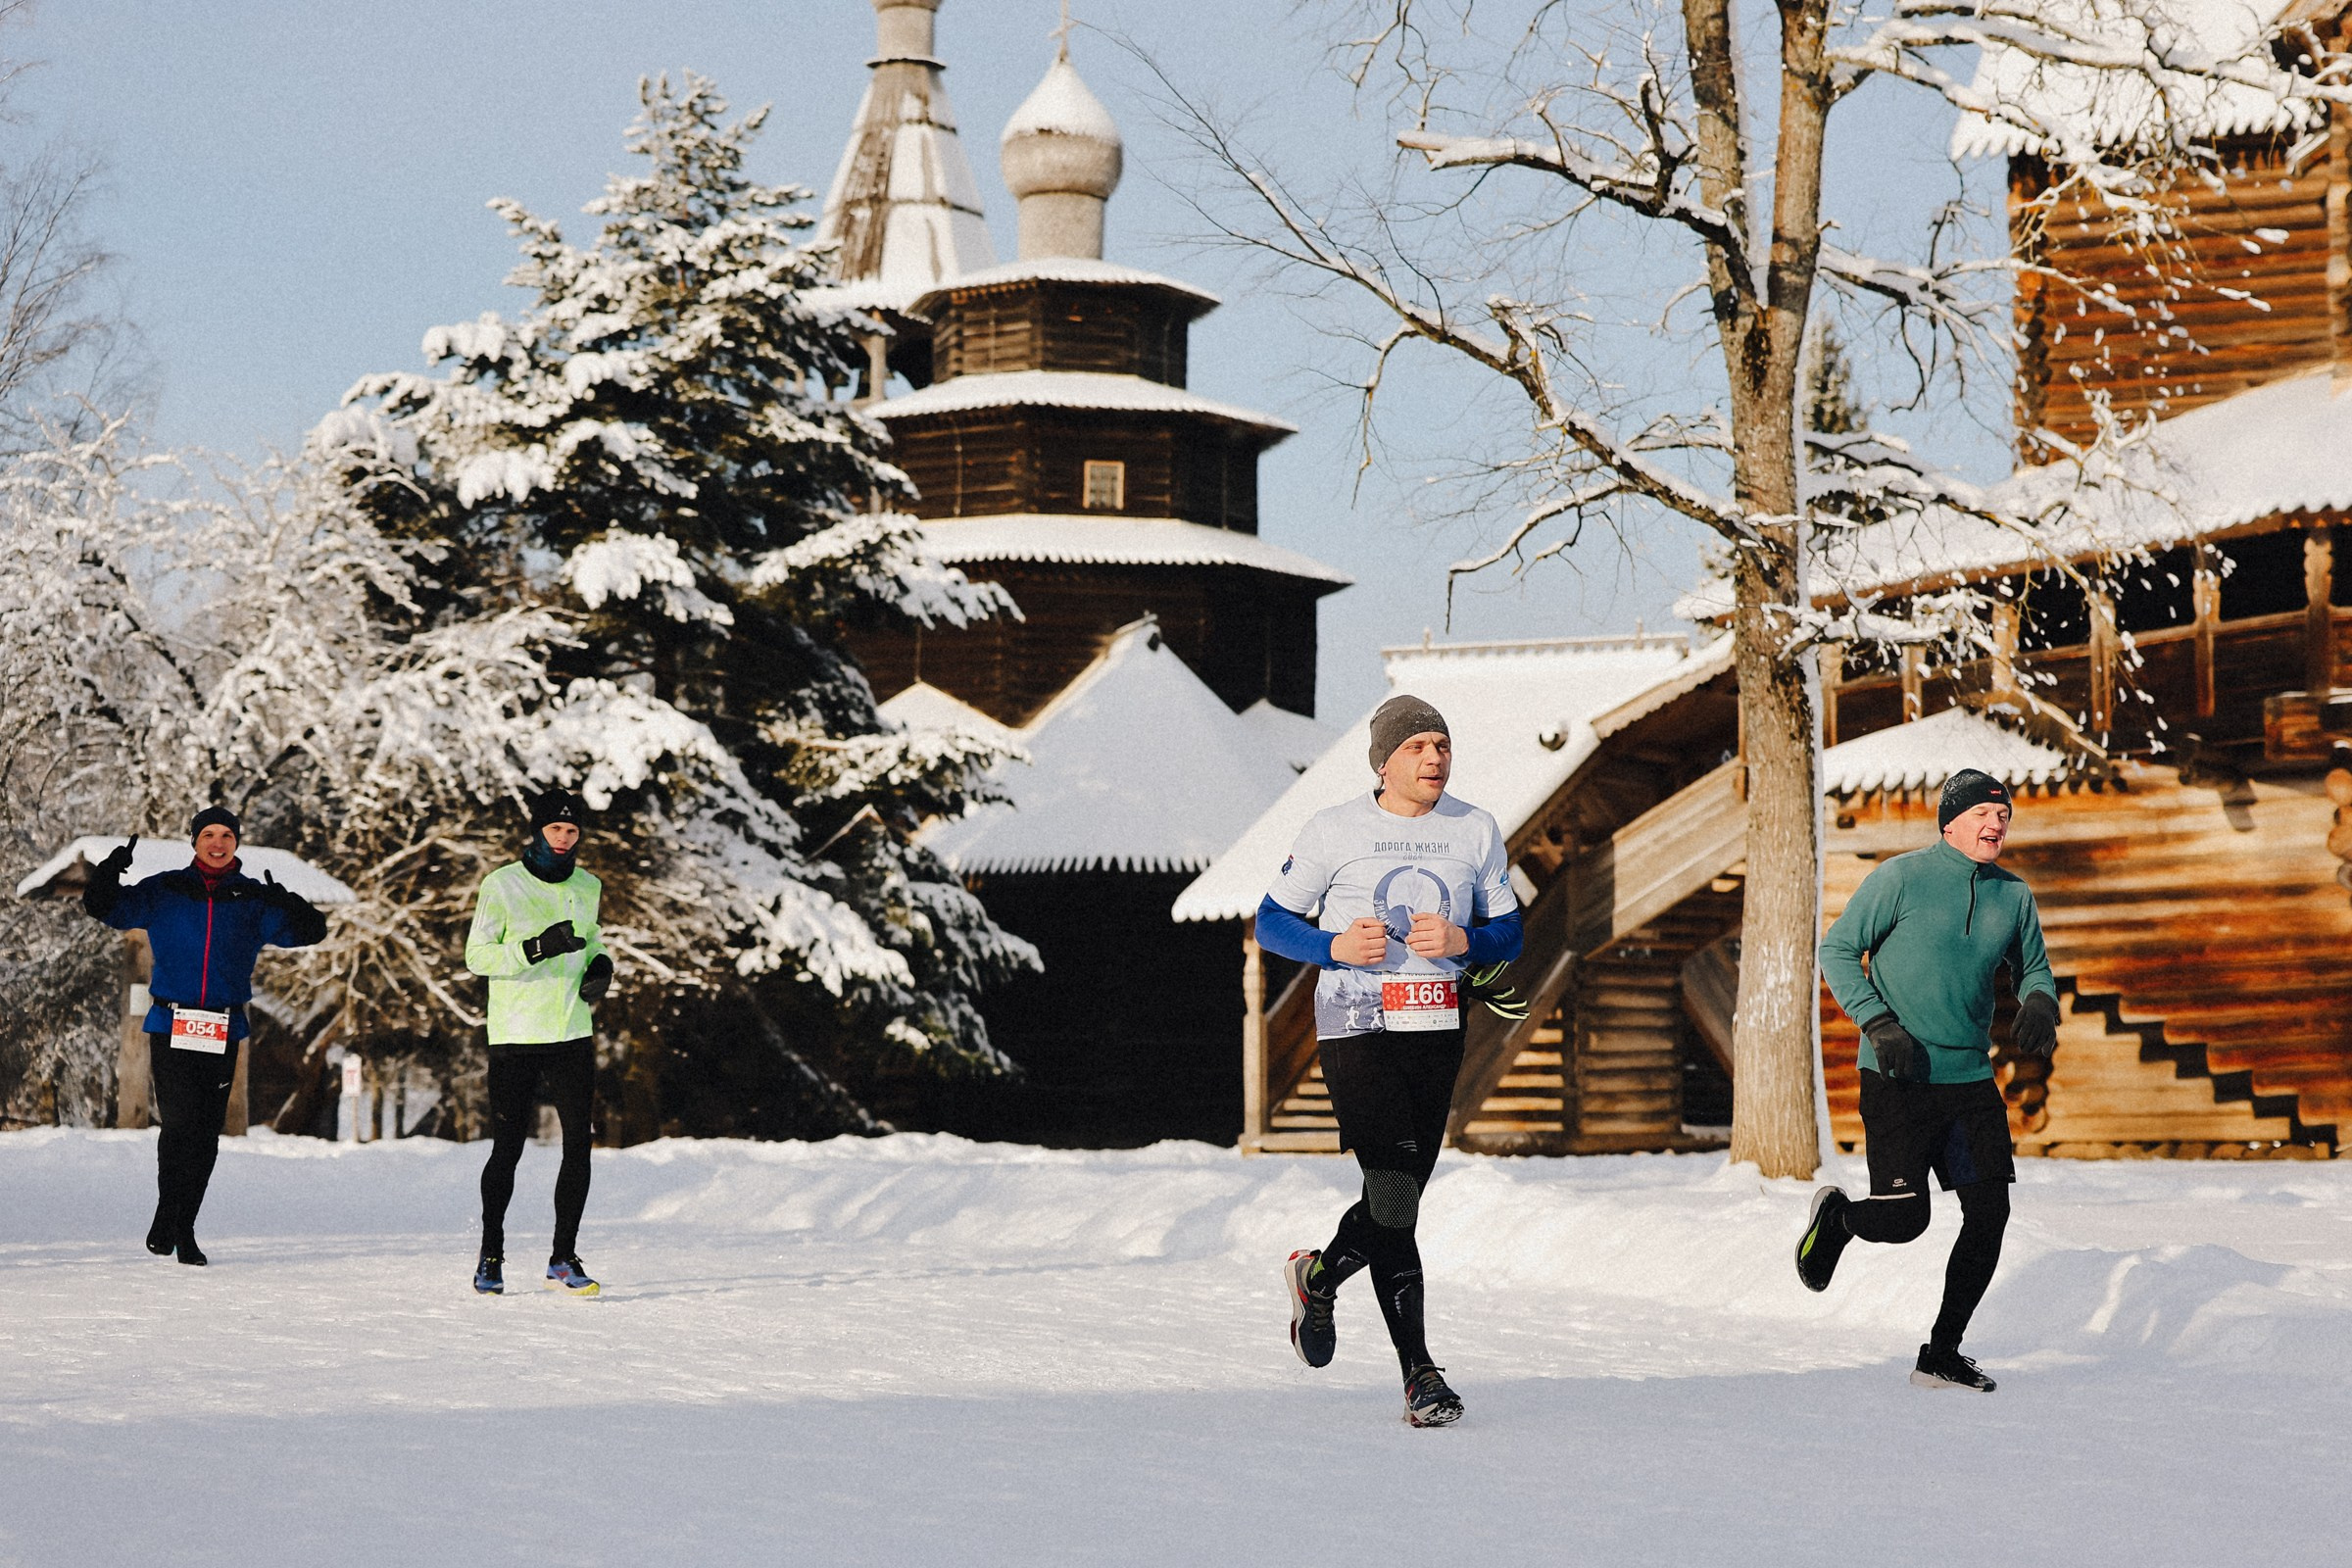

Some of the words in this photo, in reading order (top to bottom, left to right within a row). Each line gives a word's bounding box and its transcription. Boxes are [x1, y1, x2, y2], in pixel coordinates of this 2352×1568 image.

[1374, 842, 1411, 853] ДОРОГА
[1415, 842, 1449, 854] ЖИЗНИ
[1402, 852, 1423, 860] 2024
[1374, 900, 1399, 938] ЗИМНИЙ
[1404, 983, 1445, 1004] 166
[186, 1020, 217, 1037] 054
